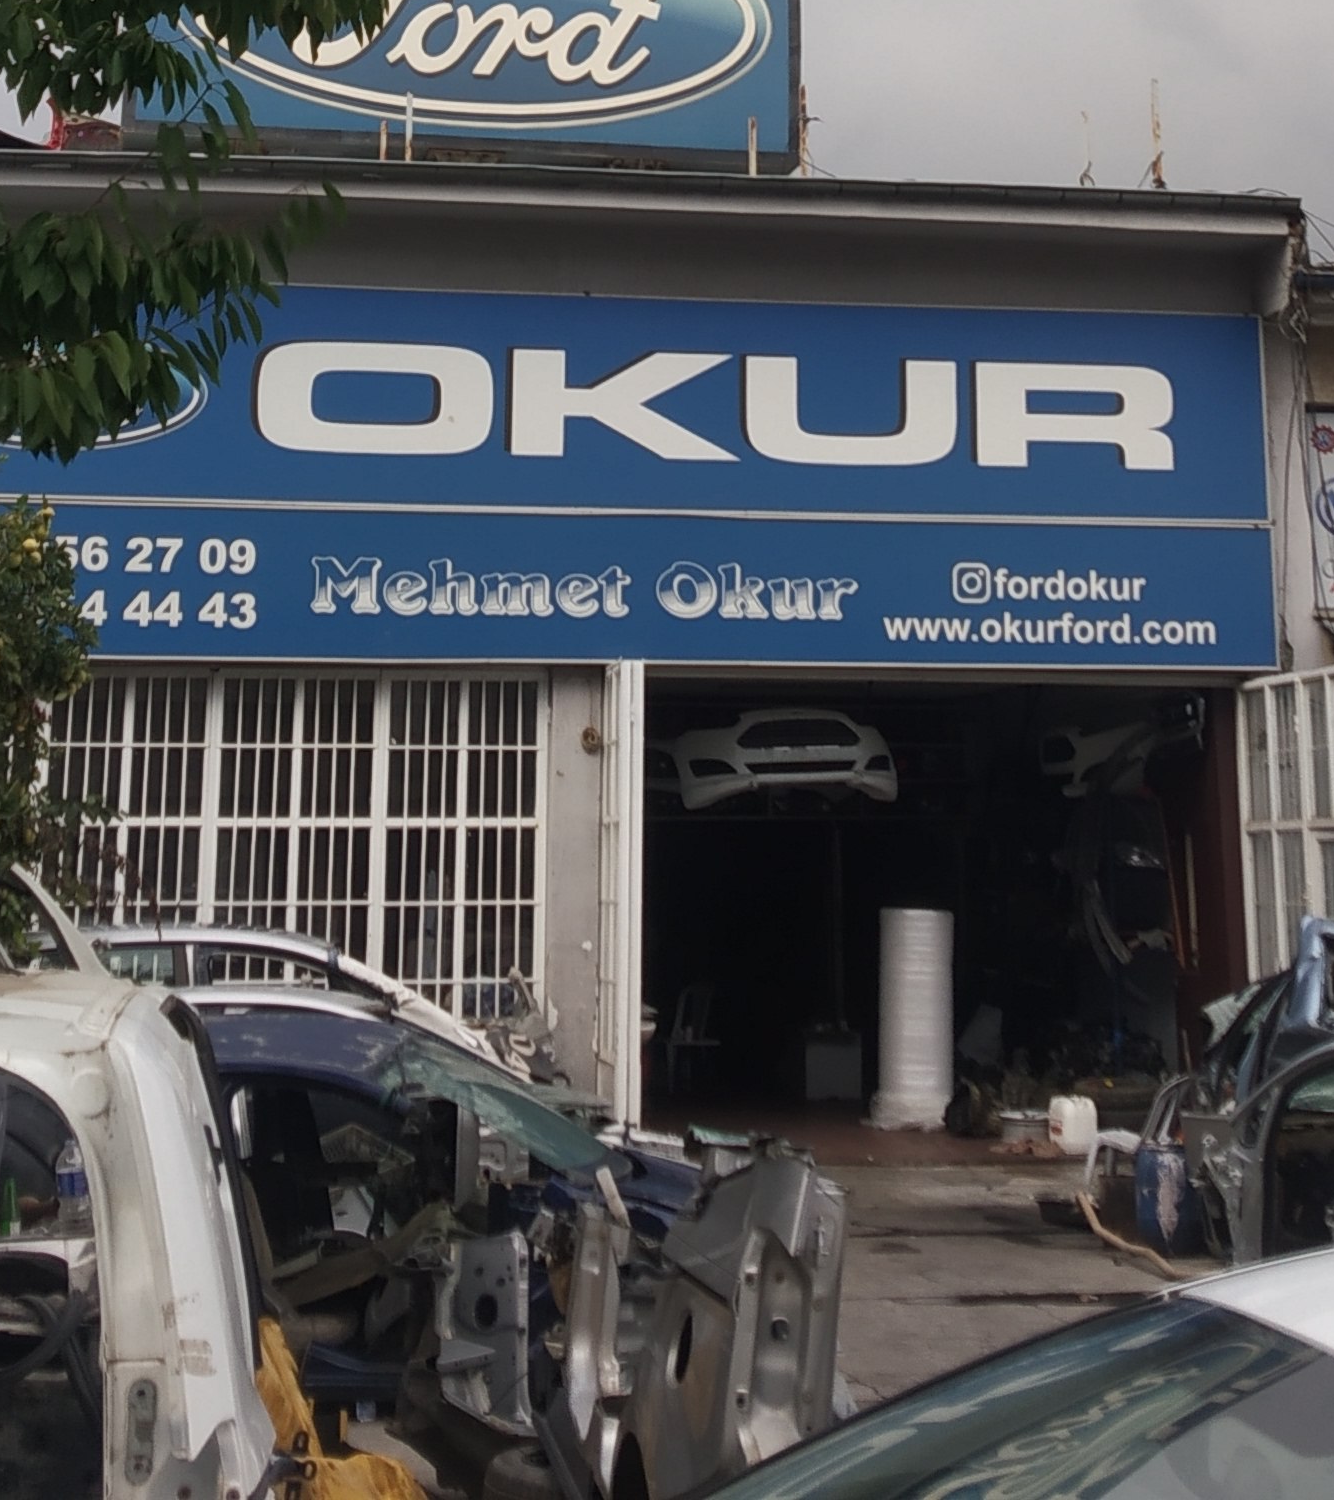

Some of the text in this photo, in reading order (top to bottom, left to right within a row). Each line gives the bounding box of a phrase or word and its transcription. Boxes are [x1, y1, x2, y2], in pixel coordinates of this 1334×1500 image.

[253, 341, 1175, 471] OKUR
[124, 537, 184, 573] 27
[199, 538, 257, 575] 09
[310, 555, 859, 622] Mehmet Okur
[994, 566, 1147, 602] fordokur
[123, 590, 183, 628] 44
[198, 591, 257, 629] 43
[883, 611, 1218, 646] www.okurford.com
